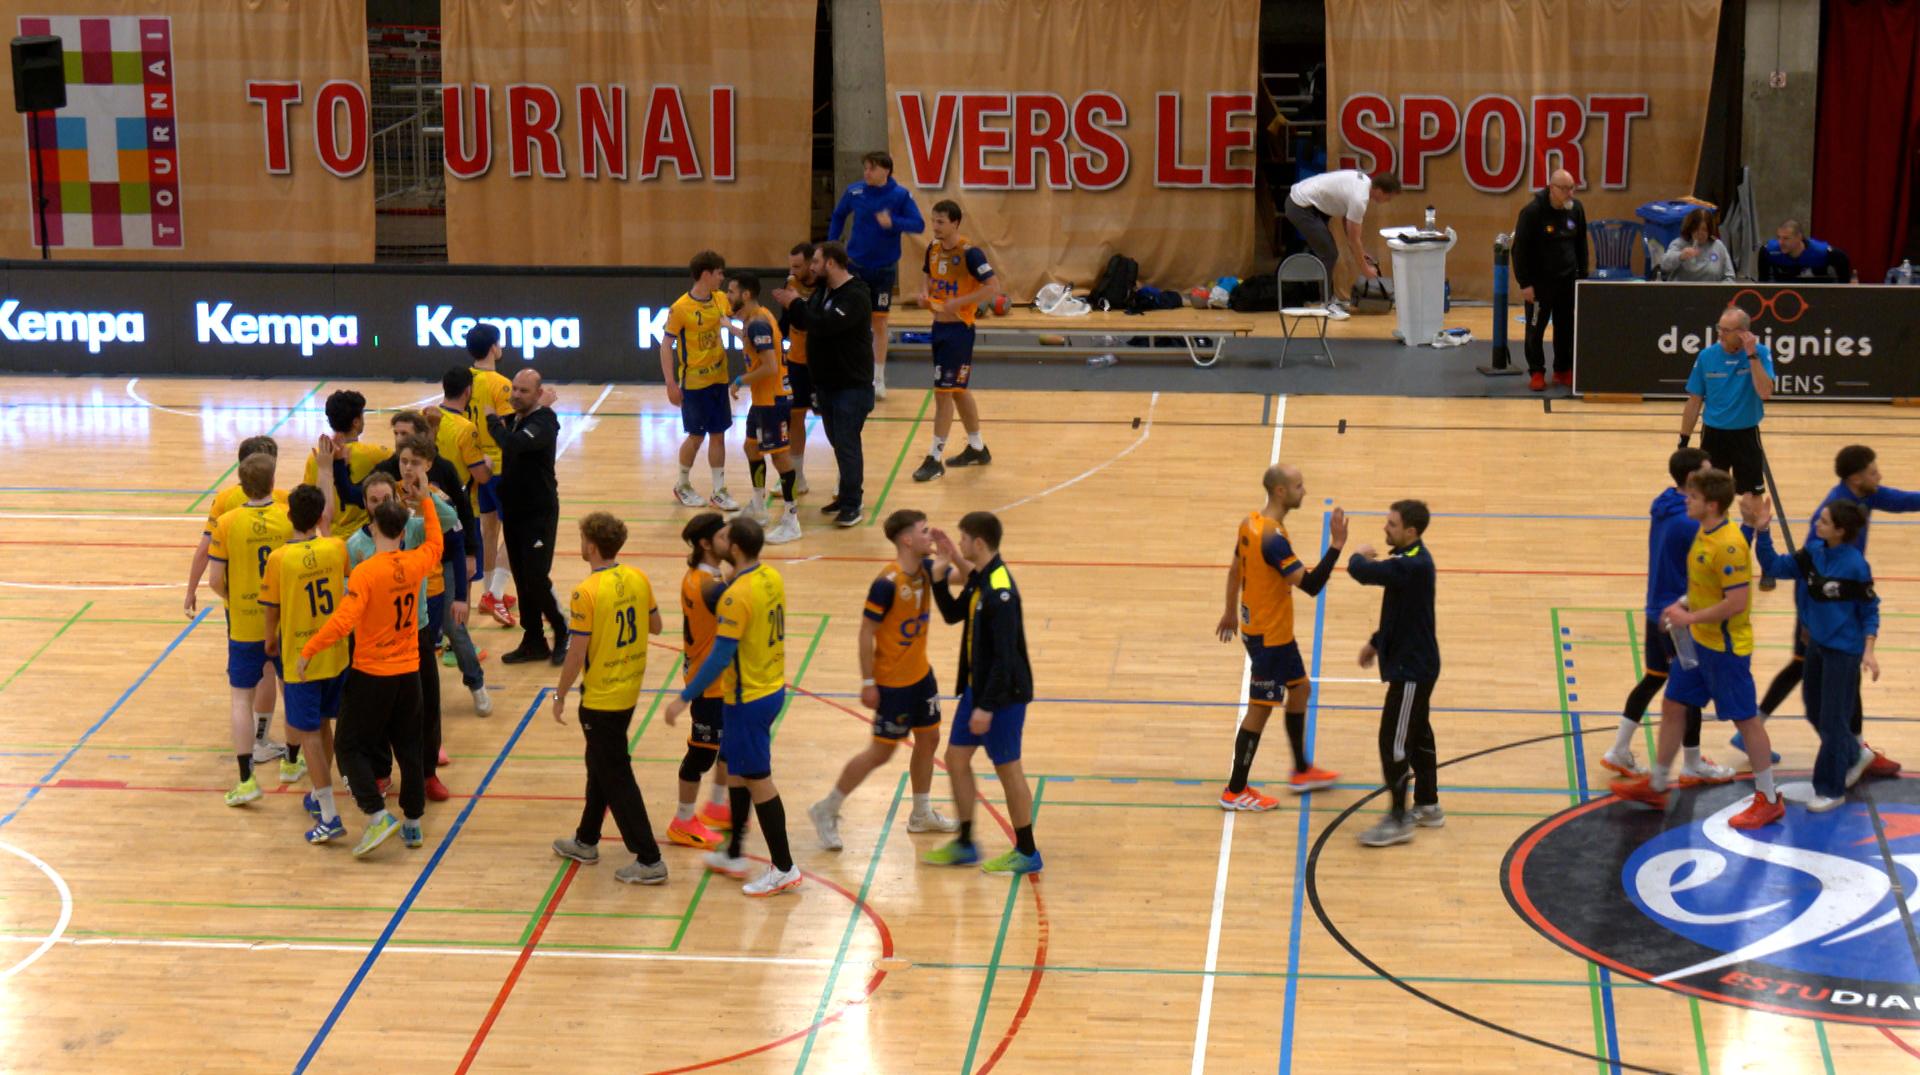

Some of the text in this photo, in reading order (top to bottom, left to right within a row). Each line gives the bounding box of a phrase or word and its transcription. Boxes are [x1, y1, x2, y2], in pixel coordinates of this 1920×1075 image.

[147, 32, 175, 238] TOURNAI
[896, 91, 1130, 191] VERS
[1153, 91, 1257, 189] LE
[1338, 92, 1649, 192] SPORT
[196, 302, 358, 356] Kempa
[415, 305, 581, 360] Kempa
[1658, 326, 1873, 364] delignies
[304, 577, 334, 618] 15
[394, 592, 415, 632] 12
[616, 606, 638, 648] 28
[768, 603, 785, 648] 20
[1720, 971, 1920, 1011] ESTUDIA
